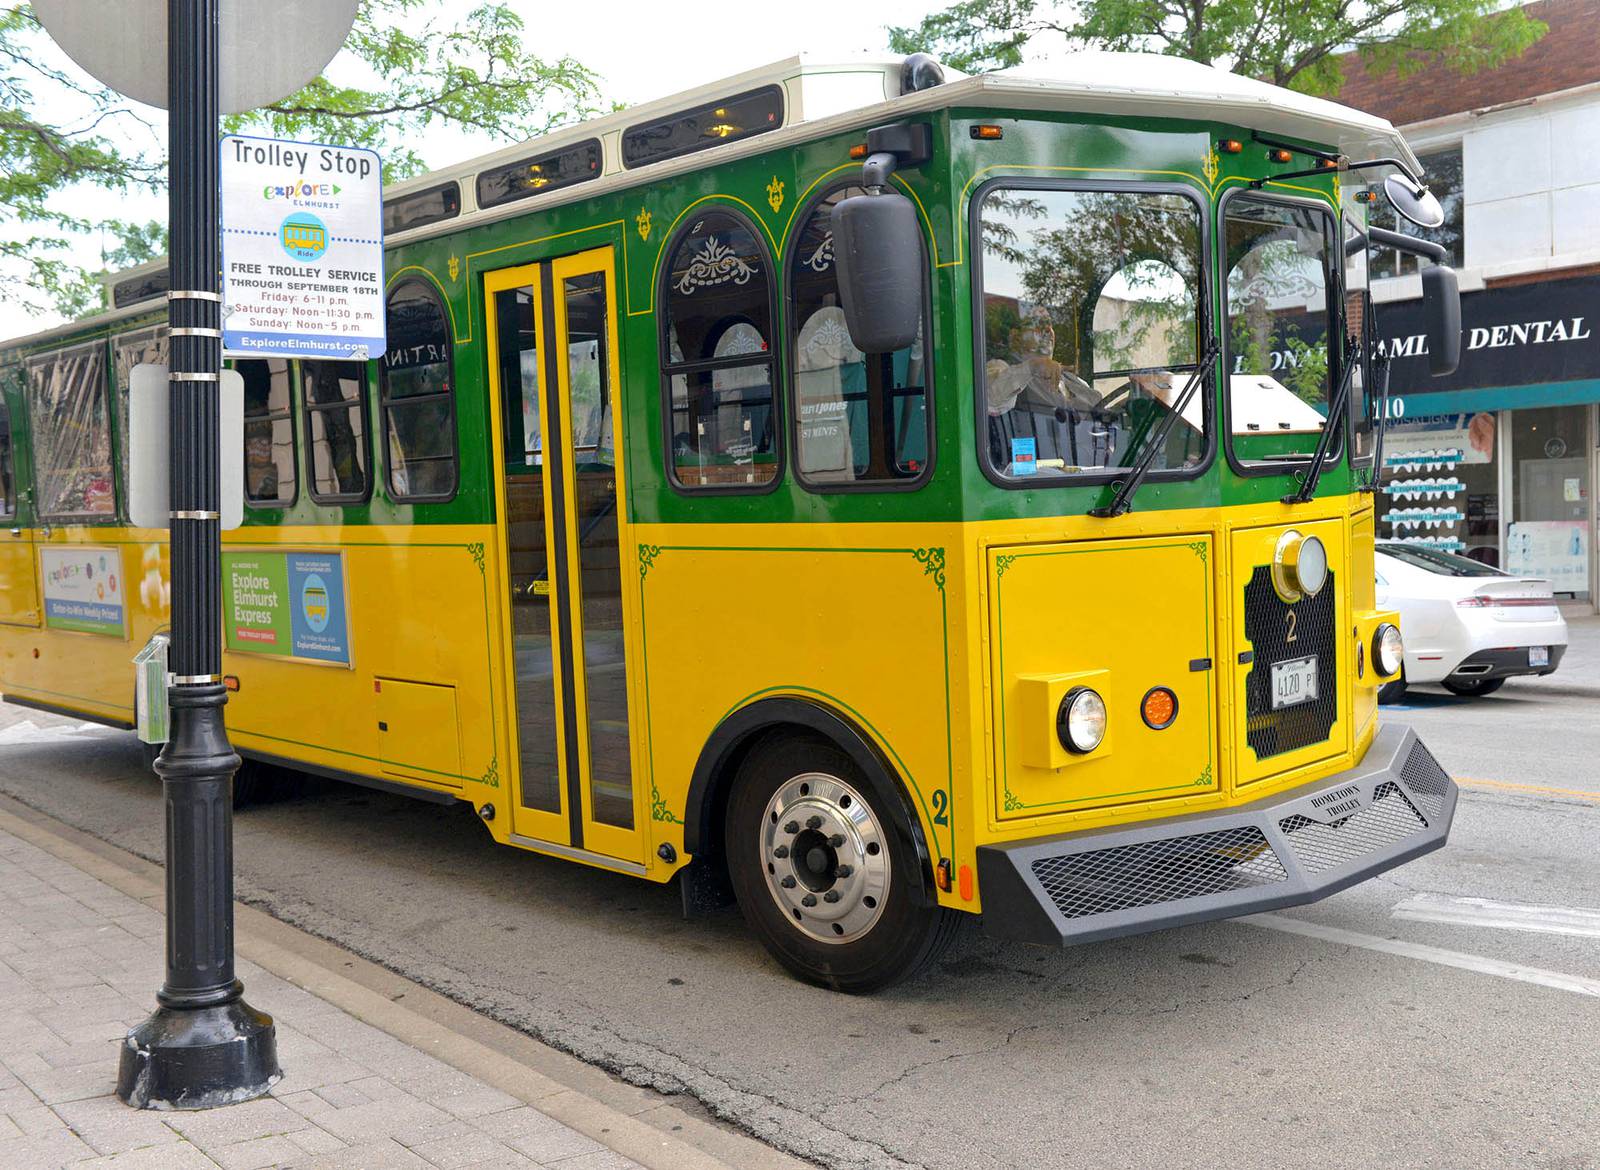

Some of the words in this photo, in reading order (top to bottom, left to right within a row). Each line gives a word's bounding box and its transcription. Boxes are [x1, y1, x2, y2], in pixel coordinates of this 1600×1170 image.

[232, 140, 308, 174] Trolley
[320, 149, 371, 179] Stop
[293, 200, 341, 210] ELMHURST
[297, 250, 314, 258] Ride
[231, 262, 262, 275] FREE
[268, 265, 321, 279] TROLLEY
[328, 270, 377, 282] SERVICE
[230, 279, 283, 289] THROUGH
[287, 282, 349, 294] SEPTEMBER
[353, 286, 379, 296] 18TH
[261, 291, 298, 305] Friday:
[329, 297, 349, 307] p.m.
[235, 303, 288, 317] Saturday:
[355, 310, 375, 321] p.m.
[249, 317, 292, 330] Sunday:
[342, 322, 362, 333] p.m.
[1467, 317, 1591, 350] DENTAL
[241, 336, 369, 351] ExploreElmhurst.com
[232, 572, 270, 592] Explore
[233, 589, 279, 608] Elmhurst
[235, 606, 272, 626] Express
[1286, 608, 1297, 642] 2
[1278, 672, 1300, 697] 4120
[1311, 784, 1361, 808] HOMETOWN
[932, 789, 948, 828] 2
[1325, 798, 1361, 817] TROLLEY
